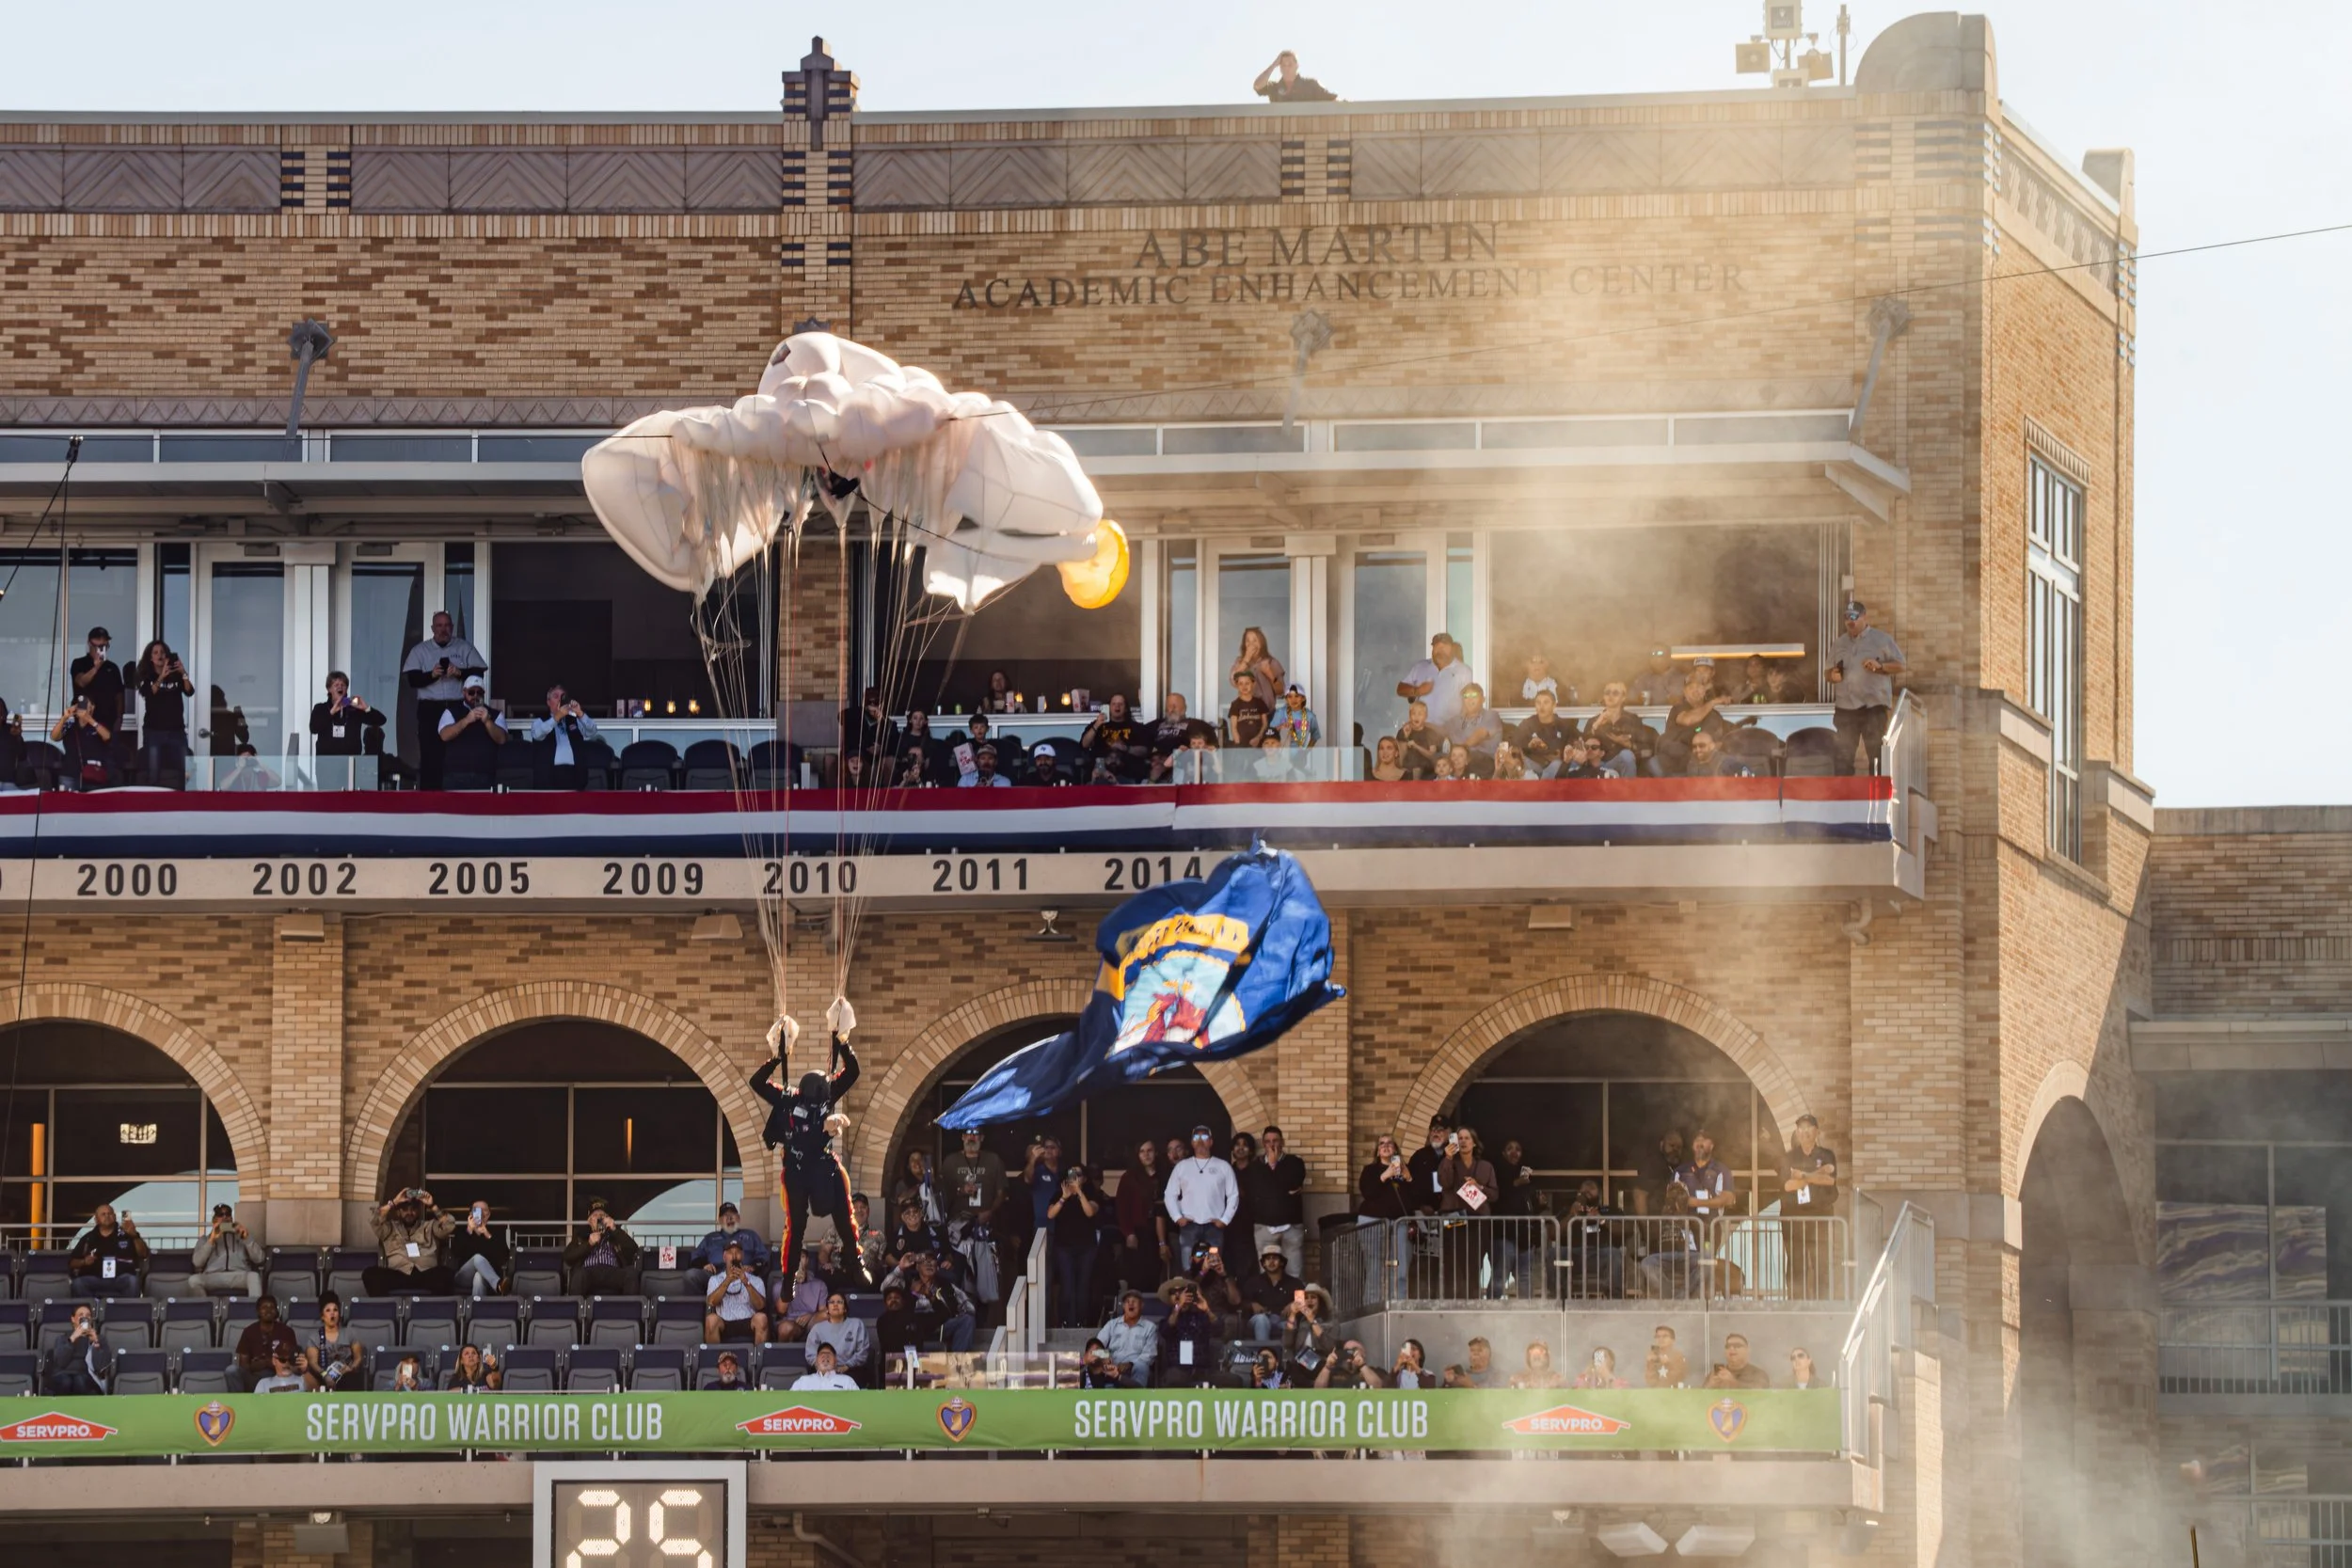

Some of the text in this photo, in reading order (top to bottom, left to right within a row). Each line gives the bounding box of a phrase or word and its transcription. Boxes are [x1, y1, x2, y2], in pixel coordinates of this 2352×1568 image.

[1133, 221, 1501, 269] ABE MARTIN
[951, 263, 1750, 309] ACADEMIC ENHANCEMENT CENTER
[77, 863, 177, 896] 2000
[252, 862, 358, 896] 2002
[428, 862, 530, 895] 2005
[603, 861, 705, 895] 2009
[763, 860, 858, 895] 2010
[932, 858, 1029, 893] 2011
[1104, 855, 1203, 892] 2014
[16, 1424, 90, 1438] SERVPRO
[306, 1402, 662, 1441] SERVPRO WARRIOR CLUB
[763, 1418, 834, 1431] SERVPRO
[1074, 1400, 1428, 1438] SERVPRO WARRIOR CLUB
[1530, 1418, 1603, 1431] SERVPRO
[566, 1490, 712, 1568] 25
